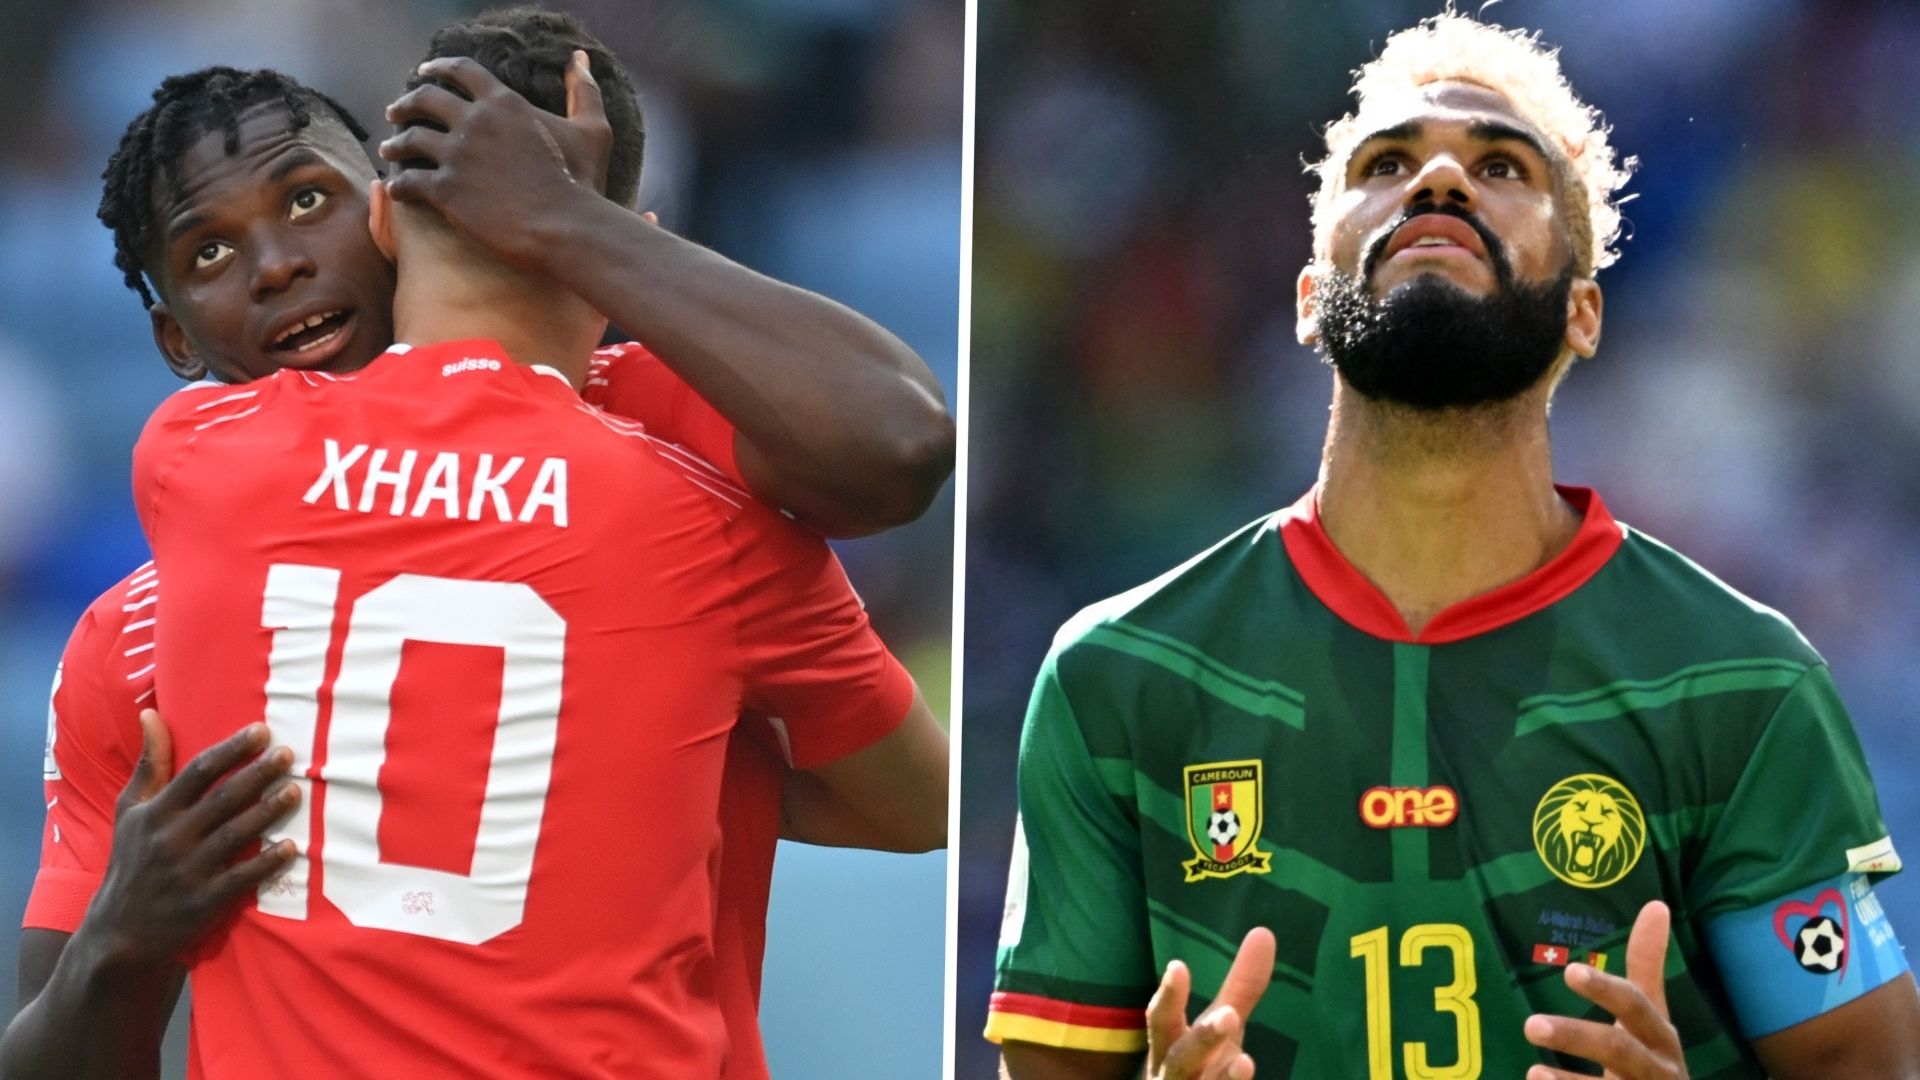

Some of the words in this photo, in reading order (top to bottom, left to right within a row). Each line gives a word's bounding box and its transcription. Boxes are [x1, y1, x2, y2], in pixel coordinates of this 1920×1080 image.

[441, 356, 501, 377] suisse
[302, 438, 569, 528] XHAKA
[257, 563, 568, 946] 10
[1193, 769, 1254, 783] CAMEROUN
[1362, 787, 1456, 826] one
[1350, 922, 1480, 1080] 13
